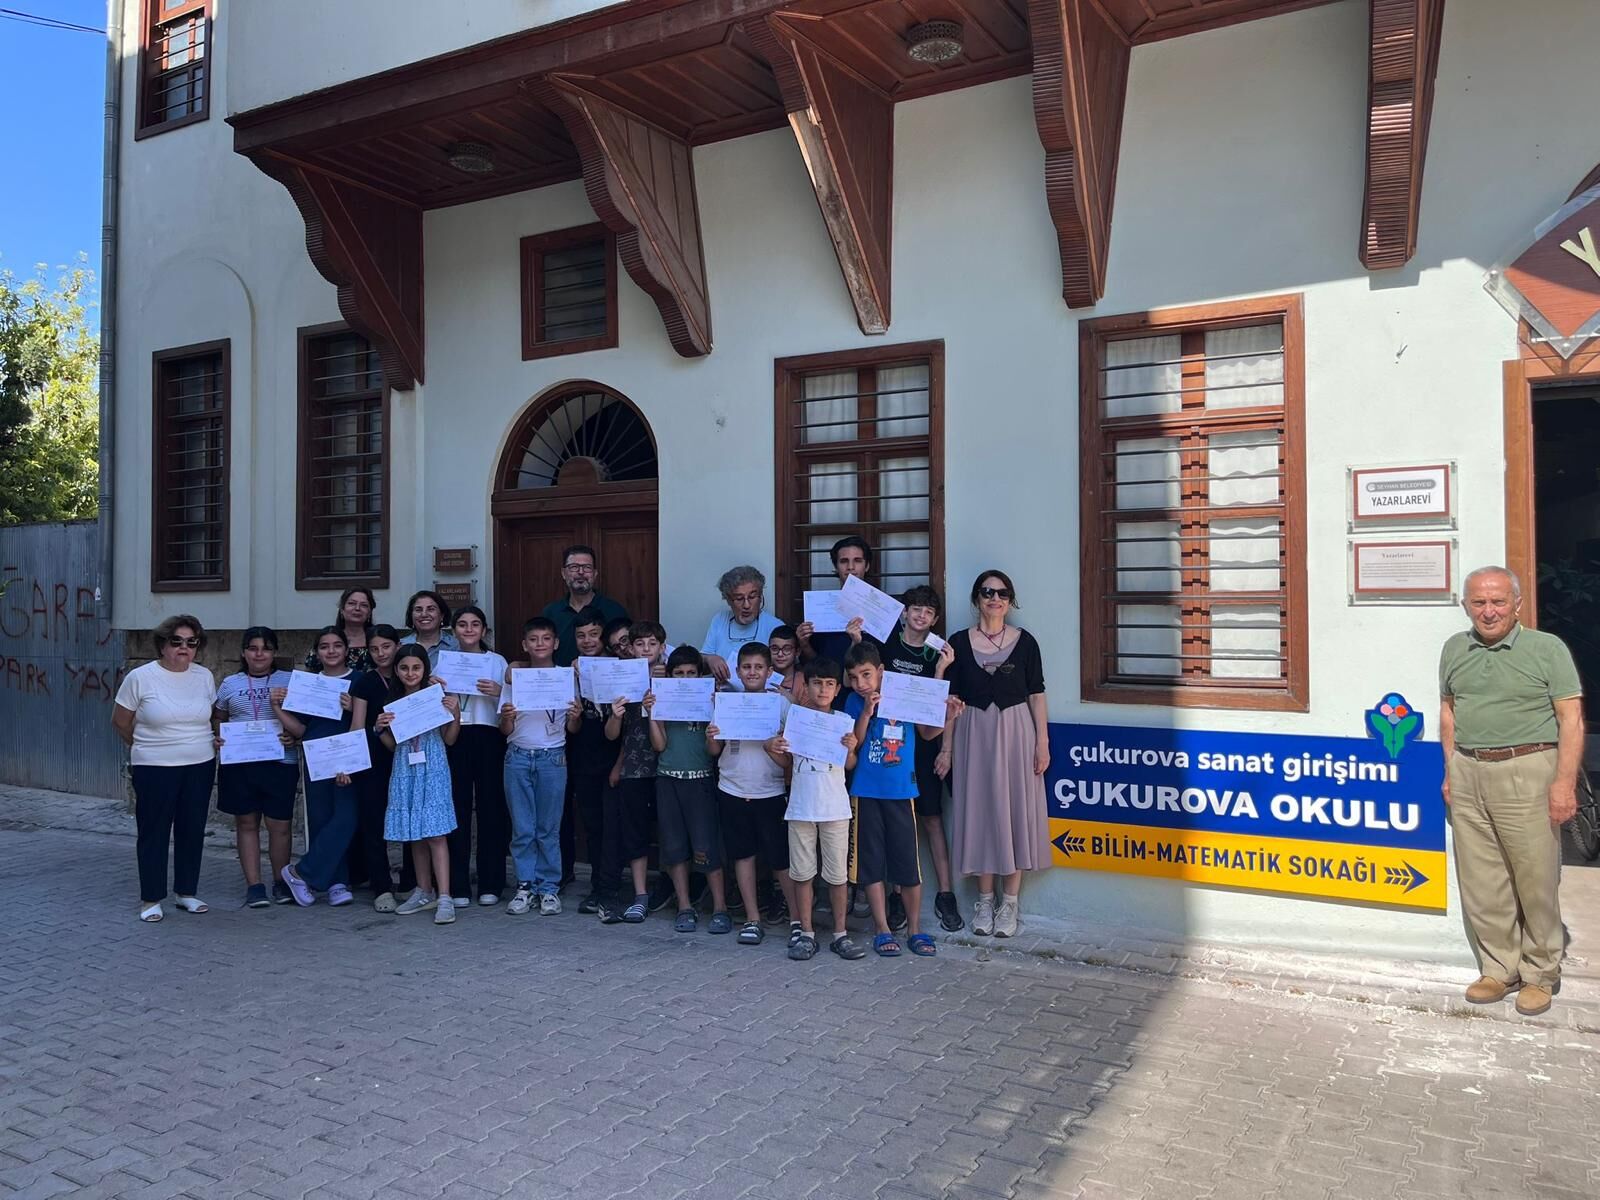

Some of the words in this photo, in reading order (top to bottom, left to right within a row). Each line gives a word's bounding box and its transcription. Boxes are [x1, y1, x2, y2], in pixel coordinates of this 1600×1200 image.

[1371, 492, 1431, 506] YAZARLAREVİ
[1069, 741, 1189, 769] çukurova
[1198, 751, 1274, 775] sanat
[1054, 779, 1259, 819] ÇUKUROVA
[1271, 795, 1419, 832] OKULU
[1091, 833, 1281, 873] BİLİM-MATEMATİK
[1288, 855, 1376, 885] SOKAĞI
